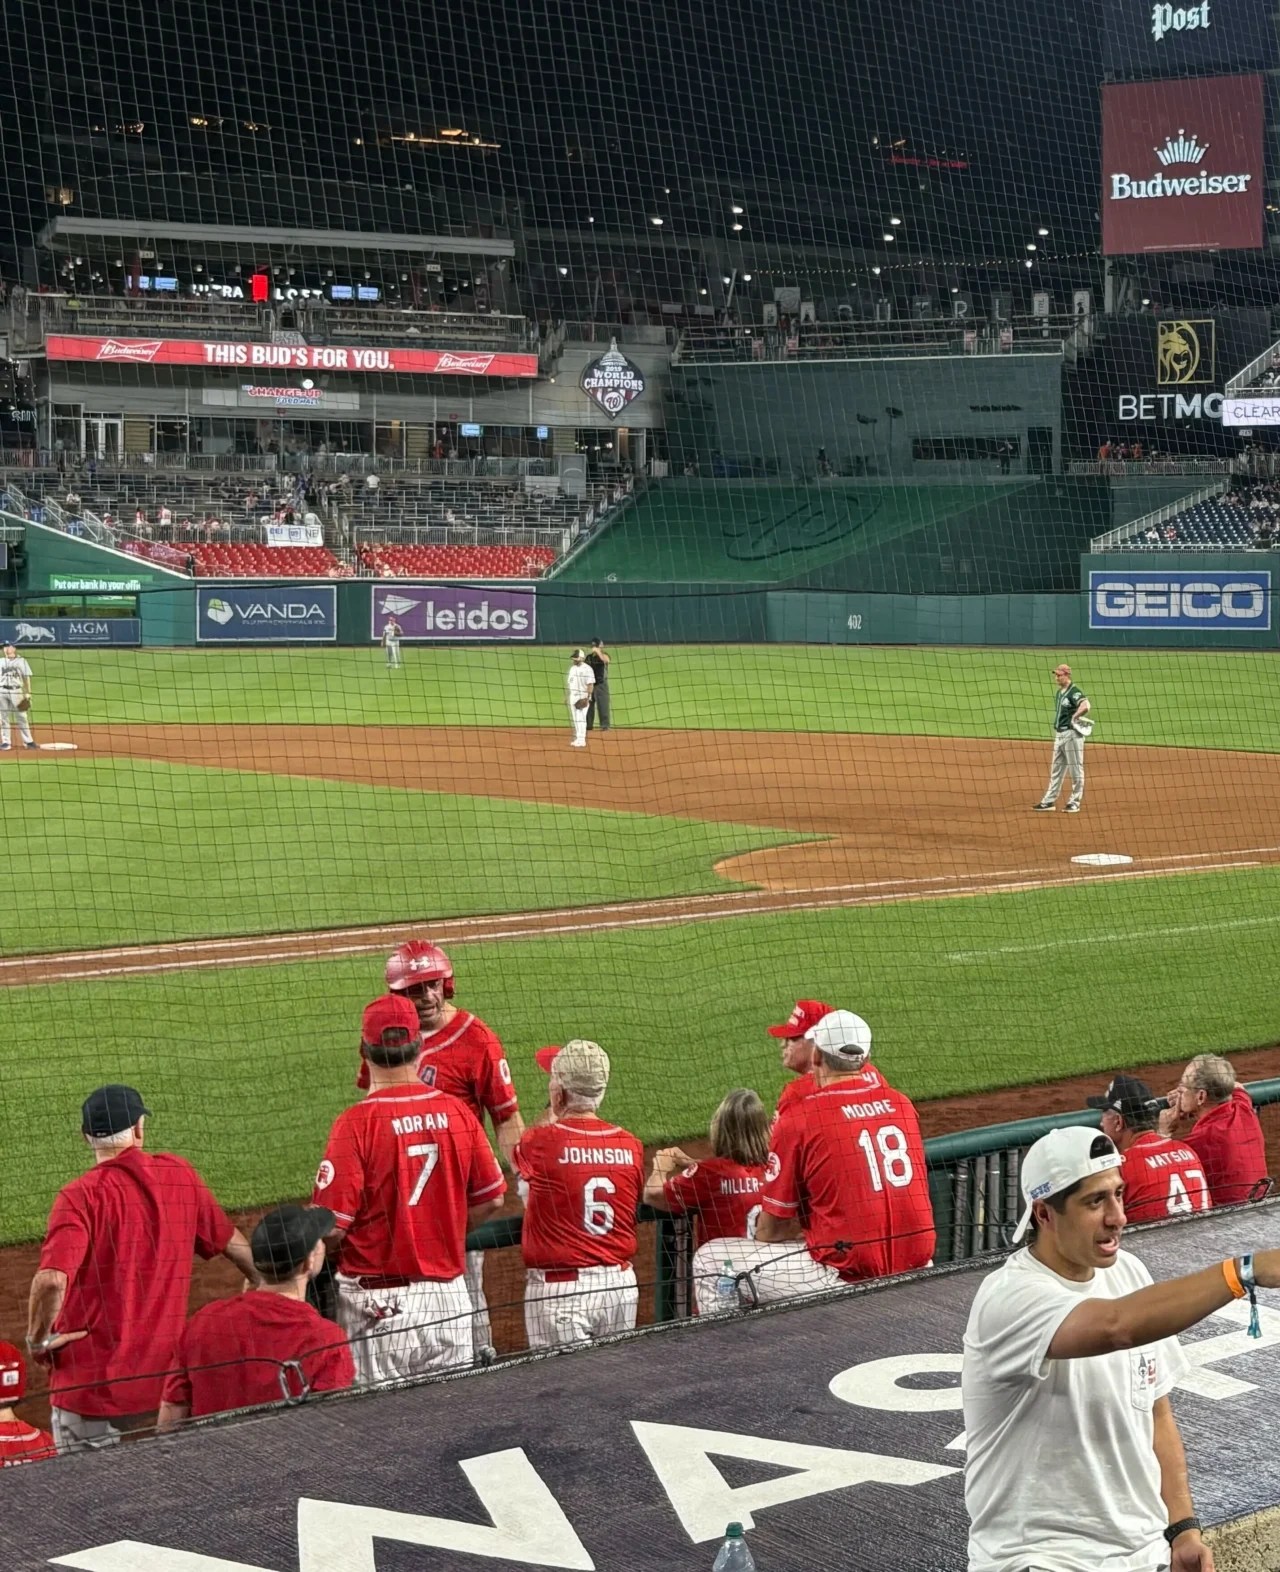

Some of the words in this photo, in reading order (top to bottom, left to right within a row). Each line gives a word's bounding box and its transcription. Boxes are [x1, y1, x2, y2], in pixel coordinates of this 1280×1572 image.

[1151, 0, 1211, 42] Post
[1110, 170, 1251, 200] Budweiser
[204, 344, 247, 363] THIS
[252, 345, 308, 367] BUD'S
[313, 348, 347, 367] FOR
[352, 350, 395, 369] YOU.
[584, 378, 643, 391] CHAMPIONS
[594, 369, 634, 379] WORLD
[54, 579, 66, 589] Put
[67, 581, 80, 589] our
[80, 579, 98, 589] bank
[100, 579, 107, 589] in
[108, 580, 125, 590] your
[235, 603, 326, 619] VANDA
[1096, 582, 1264, 618] GEICO
[426, 601, 529, 631] leidos
[848, 614, 862, 630] 402
[69, 622, 109, 634] MGM
[841, 1099, 896, 1120] MOORE
[392, 1112, 448, 1135] MORAN
[558, 1148, 634, 1166] JOHNSON
[858, 1124, 914, 1192] 18
[1145, 1149, 1196, 1169] WATSON
[407, 1143, 439, 1206] 7
[1166, 1169, 1210, 1216] 47
[583, 1176, 616, 1236] 6
